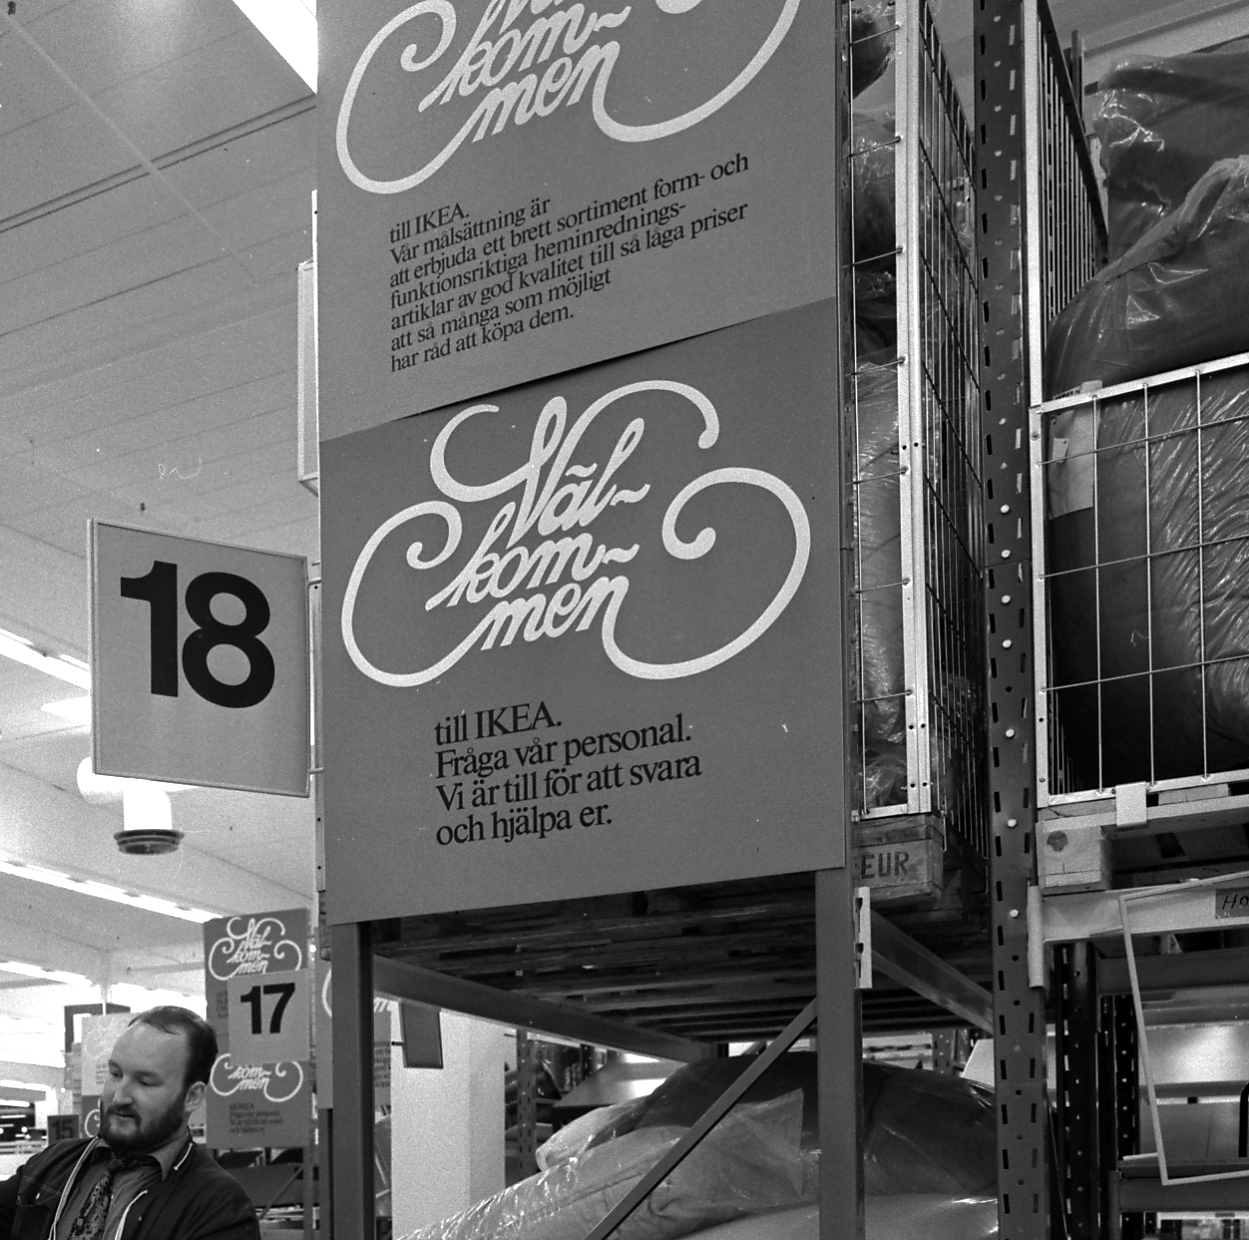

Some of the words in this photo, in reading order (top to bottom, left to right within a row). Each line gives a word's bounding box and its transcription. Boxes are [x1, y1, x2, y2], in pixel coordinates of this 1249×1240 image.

[389, 220, 411, 244] till
[415, 203, 469, 235] IKEA.
[390, 267, 410, 288] att
[413, 247, 476, 278] erbjuda
[483, 234, 505, 256] ett
[510, 220, 551, 247] brett
[556, 187, 648, 232] sortiment
[653, 172, 705, 200] form-
[710, 153, 749, 181] och
[390, 243, 419, 264] Vår
[423, 208, 526, 255] målsättning
[530, 197, 550, 218] är
[390, 252, 527, 309] funktionsriktiga
[534, 203, 686, 262] heminrednings-
[391, 299, 454, 330] artiklar
[458, 291, 477, 309] av
[480, 273, 513, 305] god
[519, 253, 584, 289] kvalitet
[590, 241, 615, 267] till
[620, 234, 641, 257] så
[646, 225, 685, 249] låga
[690, 203, 748, 239] priser
[391, 331, 412, 351] att
[418, 322, 435, 342] så
[441, 306, 500, 335] många
[505, 291, 543, 315] som
[548, 268, 611, 302] möjligt
[391, 351, 419, 373] har
[424, 338, 451, 362] råd
[456, 333, 478, 352] att
[482, 320, 524, 345] köpa
[529, 306, 574, 330] dem.
[120, 560, 276, 709] 18
[434, 712, 469, 746] till
[475, 700, 563, 739] IKEA.
[435, 747, 509, 779] Fråga
[514, 737, 558, 767] vår
[563, 712, 692, 767] personal.
[435, 782, 465, 811] Vi
[471, 779, 500, 808] är
[504, 771, 539, 803] till
[544, 767, 582, 798] för
[586, 763, 624, 792] att
[629, 754, 703, 786] svara
[436, 814, 485, 846] och
[490, 805, 573, 844] hjälpa
[579, 803, 613, 828] er.
[860, 850, 910, 880] EUR
[240, 982, 296, 1035] 17
[52, 1119, 74, 1140] 15
